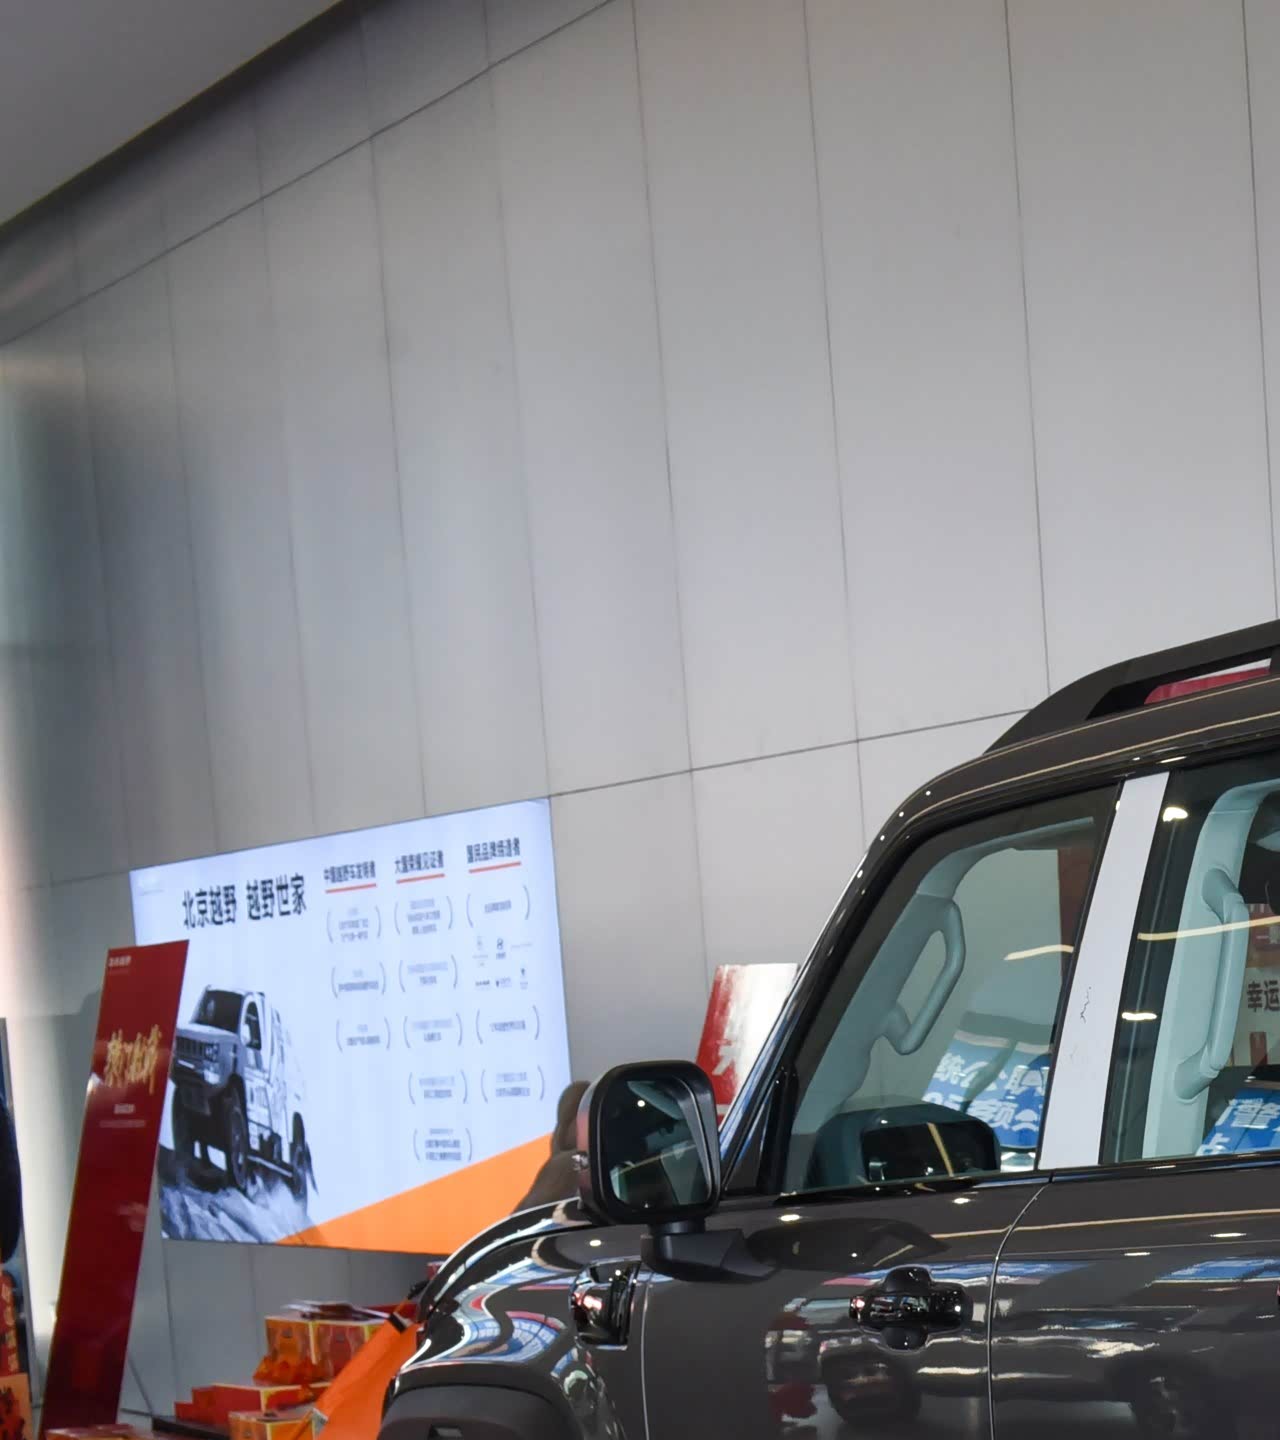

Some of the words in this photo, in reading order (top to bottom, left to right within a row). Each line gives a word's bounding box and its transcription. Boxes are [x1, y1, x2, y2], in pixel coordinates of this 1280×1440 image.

[182, 884, 237, 930] 北京越野
[246, 872, 307, 921] 越野世家
